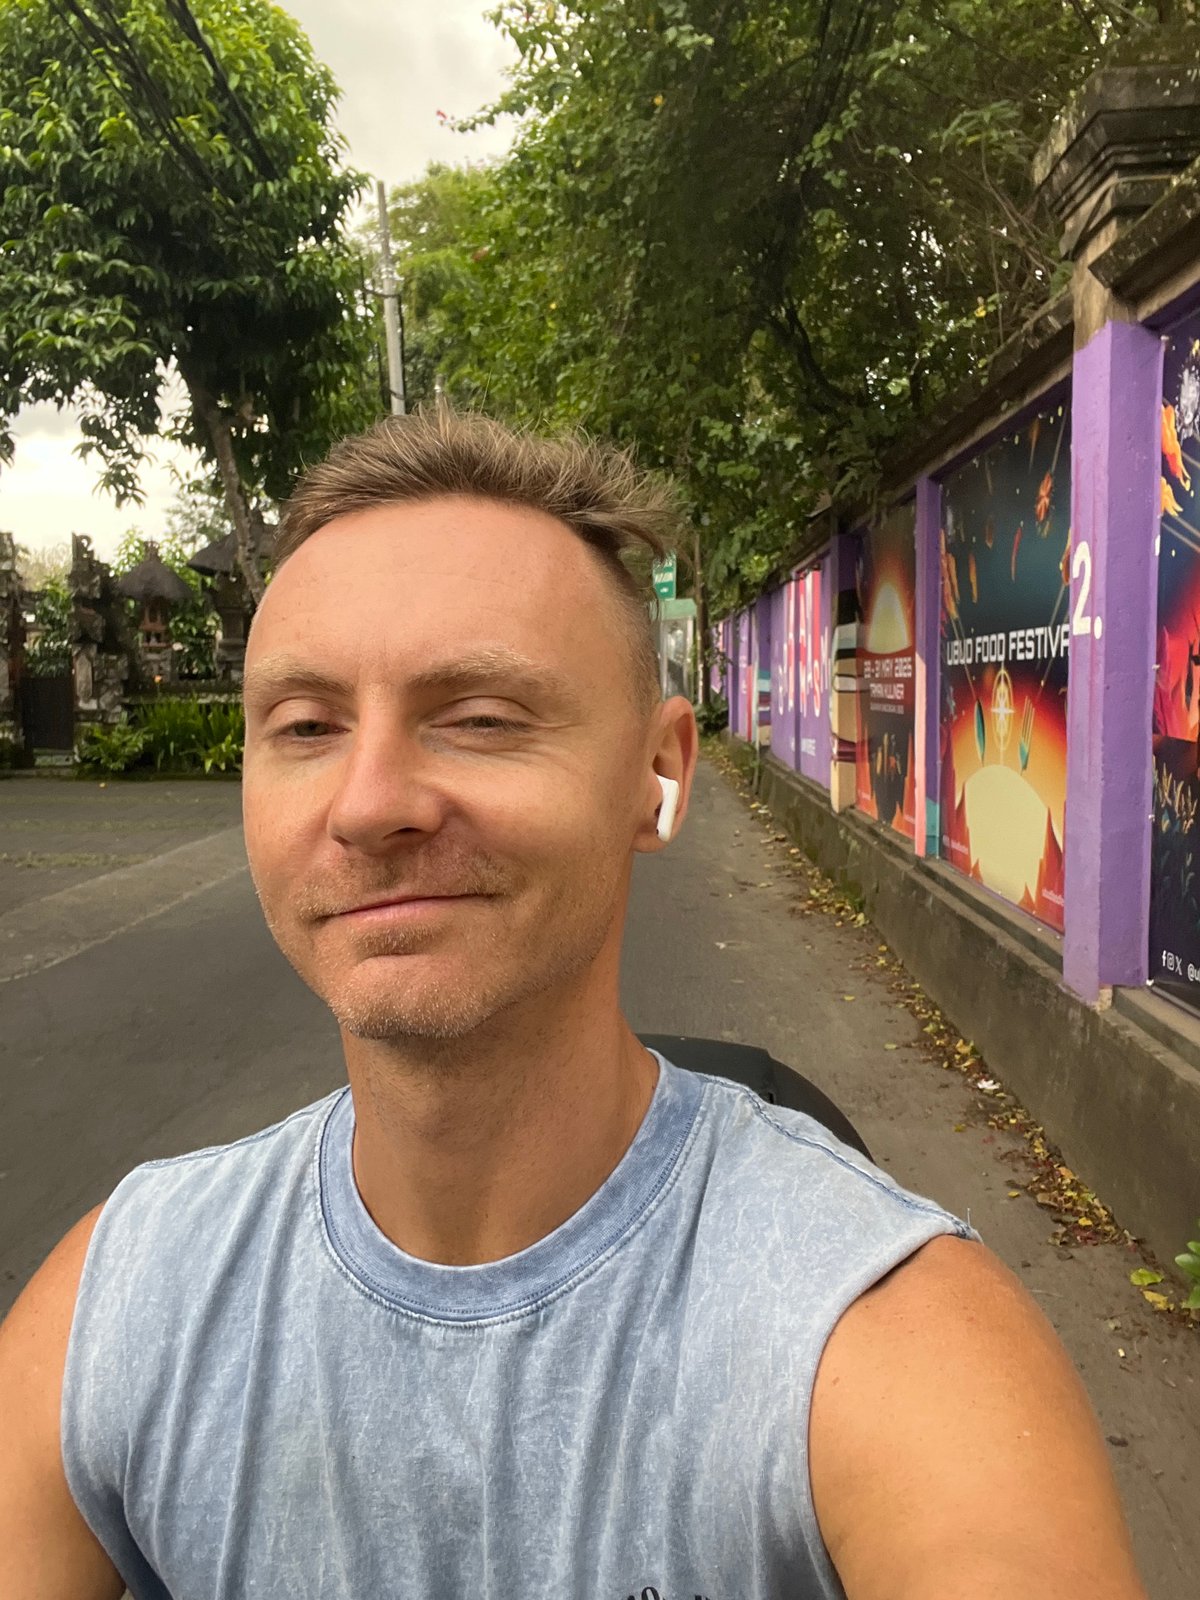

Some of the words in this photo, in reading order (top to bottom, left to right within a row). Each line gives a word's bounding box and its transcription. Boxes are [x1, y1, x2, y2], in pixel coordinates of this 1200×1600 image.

[1072, 541, 1103, 640] 2.
[947, 638, 973, 665] UBUD
[975, 632, 1006, 663] FOOD
